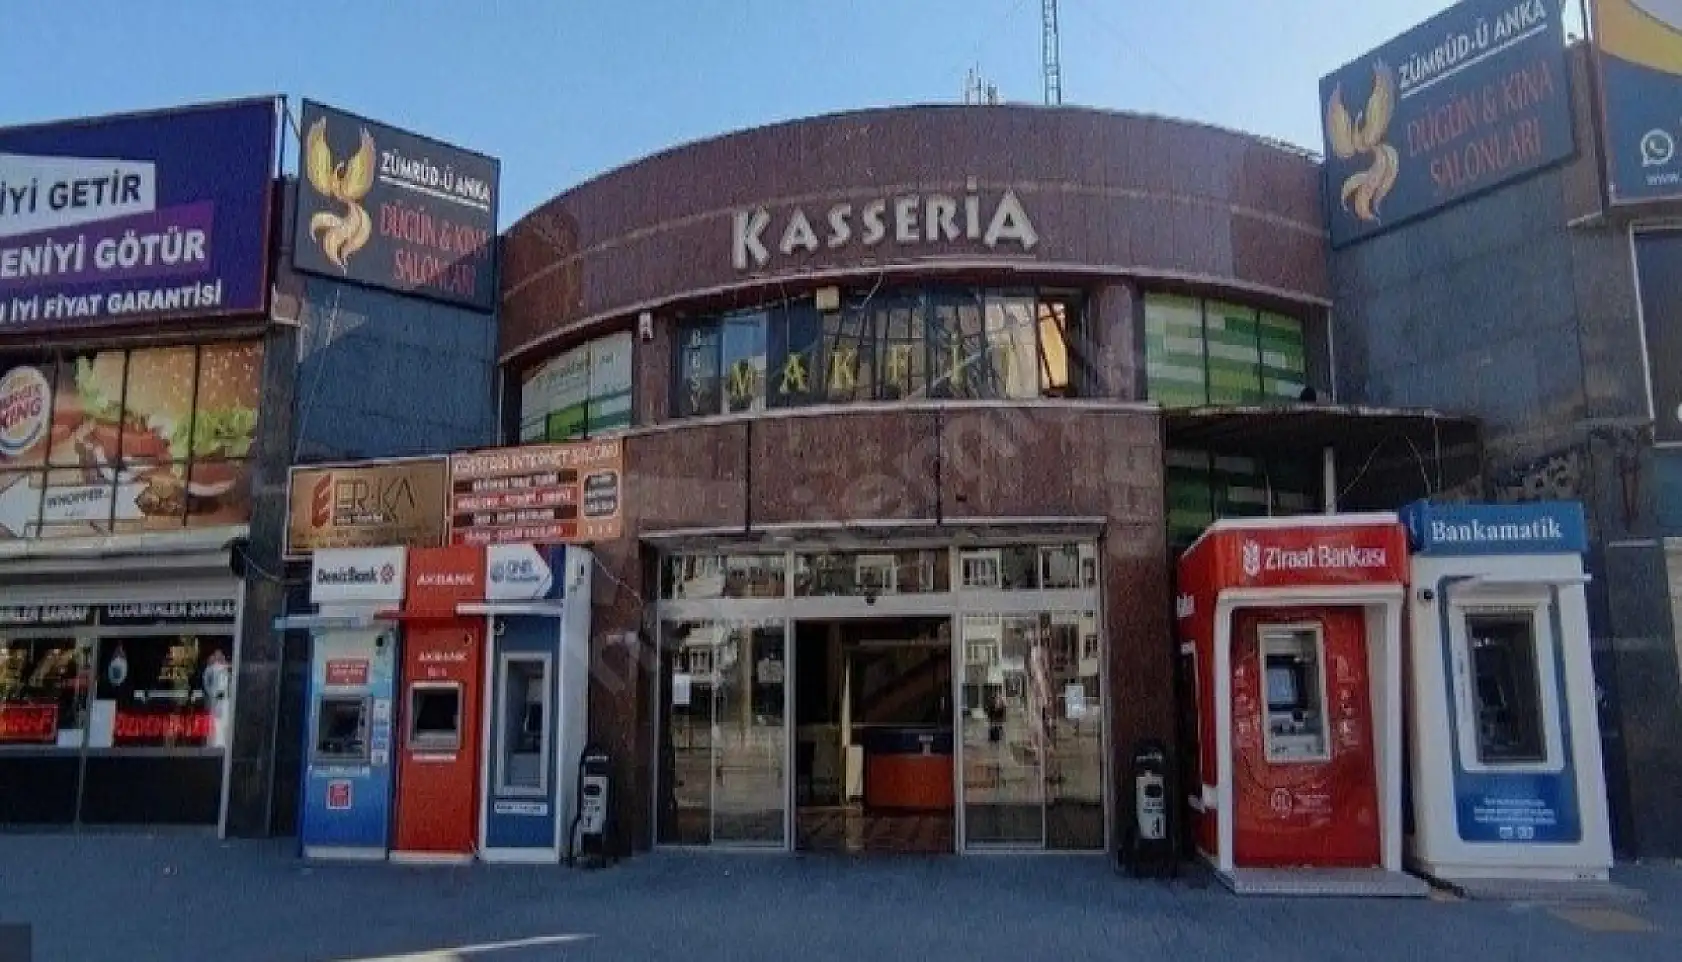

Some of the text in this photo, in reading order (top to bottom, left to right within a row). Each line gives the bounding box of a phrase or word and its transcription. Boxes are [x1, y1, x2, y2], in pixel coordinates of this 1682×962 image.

[1399, 0, 1547, 90] ZÜMRÜD-Ü ANKA
[1483, 86, 1500, 124] &
[1503, 60, 1554, 112] KINA
[1430, 117, 1543, 190] SALONLARI
[48, 168, 143, 211] GETİR
[455, 176, 490, 201] ANKA
[438, 219, 450, 252] &
[730, 174, 1040, 270] KASSERİA
[94, 225, 206, 270] GÖTÜR
[44, 291, 102, 318] FİYAT
[107, 278, 222, 314] GARANTİSİ
[1430, 517, 1563, 542] Bankamatik
[318, 565, 378, 584] DenizBank
[1264, 543, 1387, 571] Ziraat Bankası
[416, 573, 475, 586] AKBANK
[418, 650, 469, 662] AKBANK
